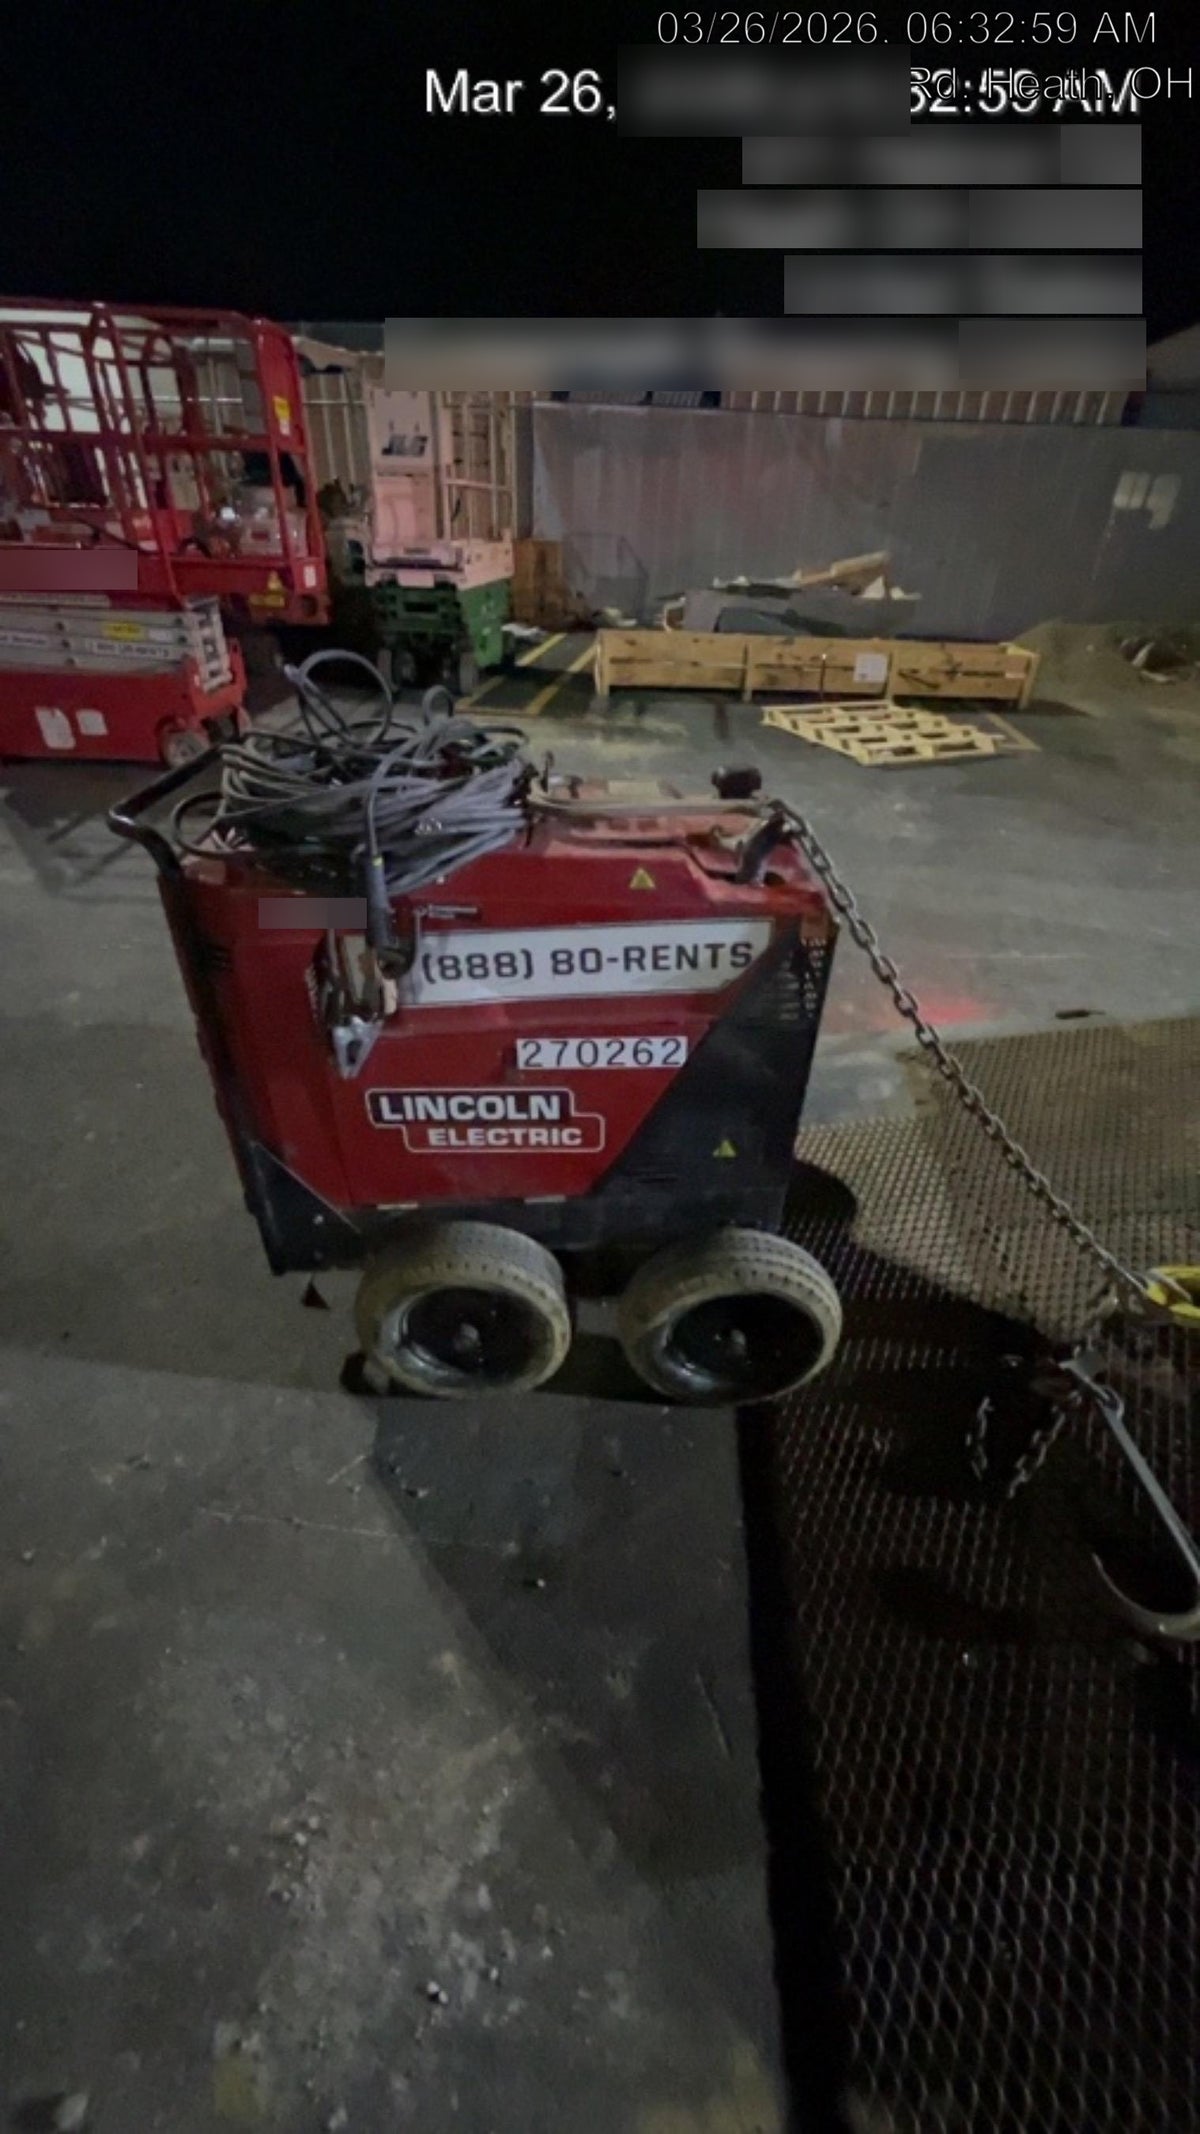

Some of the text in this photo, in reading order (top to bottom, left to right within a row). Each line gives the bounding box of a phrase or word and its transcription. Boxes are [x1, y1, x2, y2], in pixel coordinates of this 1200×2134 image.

[422, 942, 755, 985] (888) 80-RENTS
[520, 1038, 685, 1067] 270262
[379, 1094, 561, 1122] LINCOLN
[428, 1127, 583, 1146] ELECTRIC
